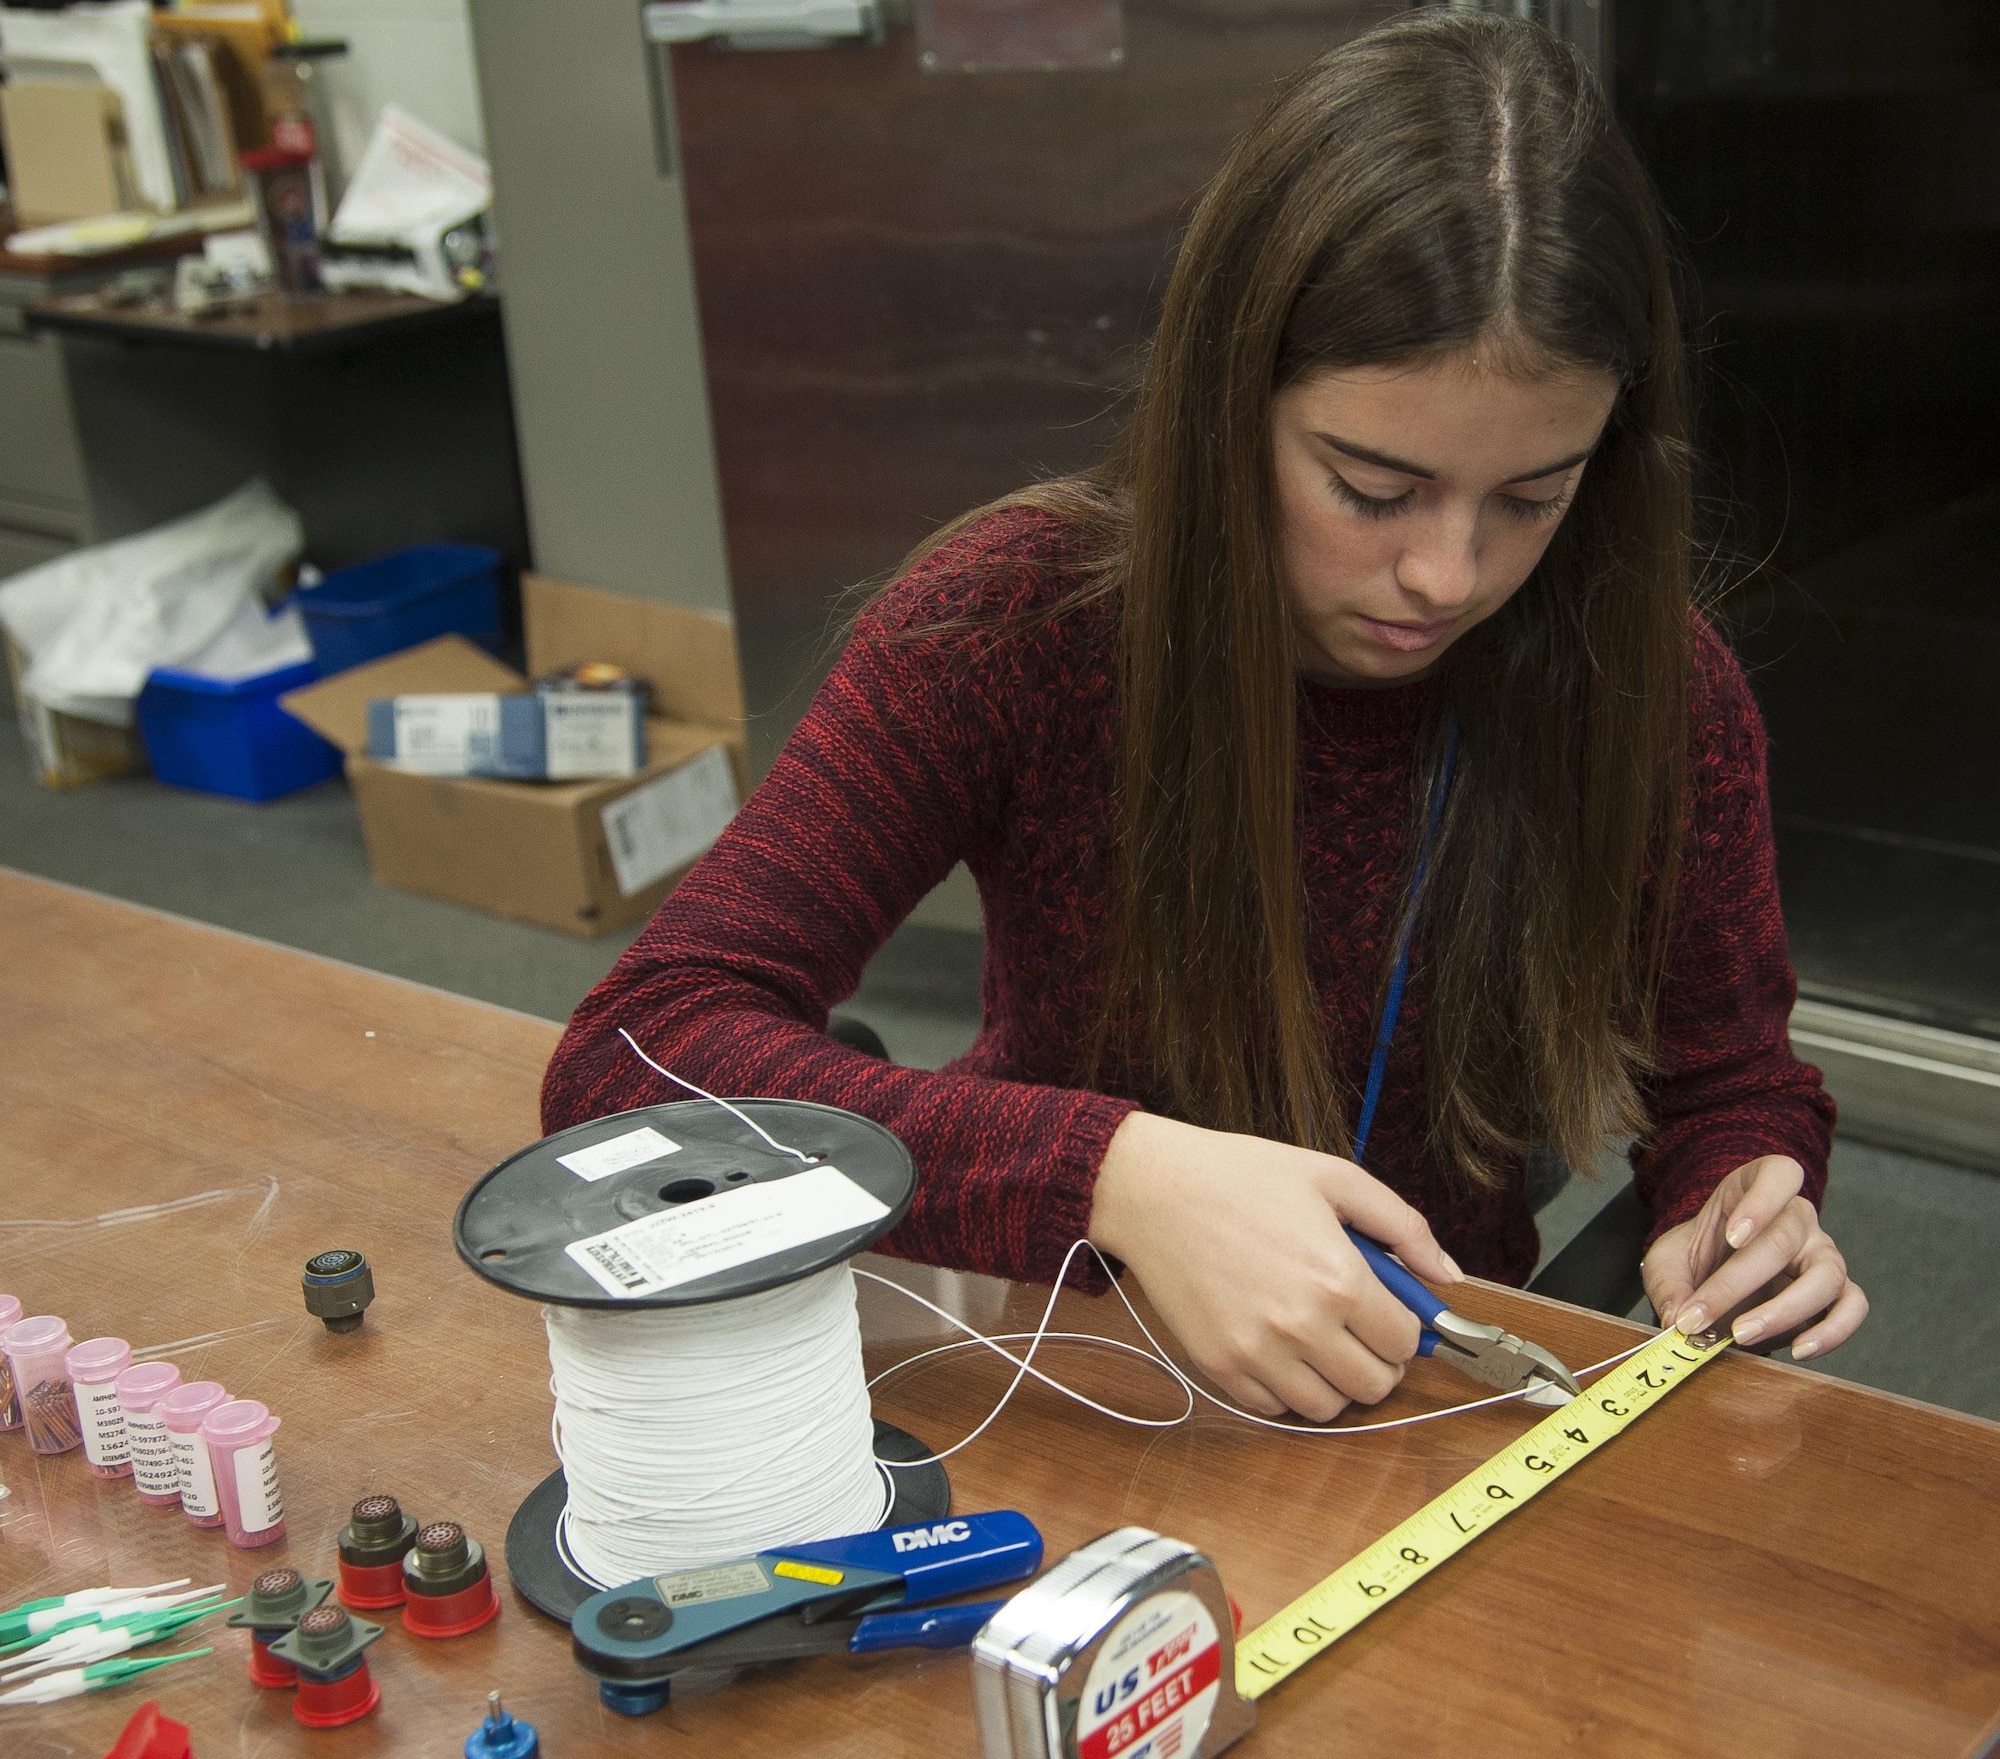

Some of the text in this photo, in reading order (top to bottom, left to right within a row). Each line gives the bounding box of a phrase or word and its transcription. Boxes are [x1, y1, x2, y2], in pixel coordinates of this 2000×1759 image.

[1635, 1369, 1667, 1388] 2
[1601, 1399, 1629, 1416] 3
[1563, 1427, 1589, 1444] 4
[1525, 1455, 1556, 1473] 5
[1486, 1485, 1514, 1500] 6
[1450, 1512, 1477, 1533] 7
[891, 1521, 972, 1553] DMC
[1400, 1547, 1429, 1565] 8
[1358, 1580, 1387, 1598] 9
[1293, 1617, 1337, 1645] 10
[1250, 1652, 1290, 1675] 11
[1094, 1665, 1140, 1716] US
[1106, 1668, 1194, 1753] 25 FEET
